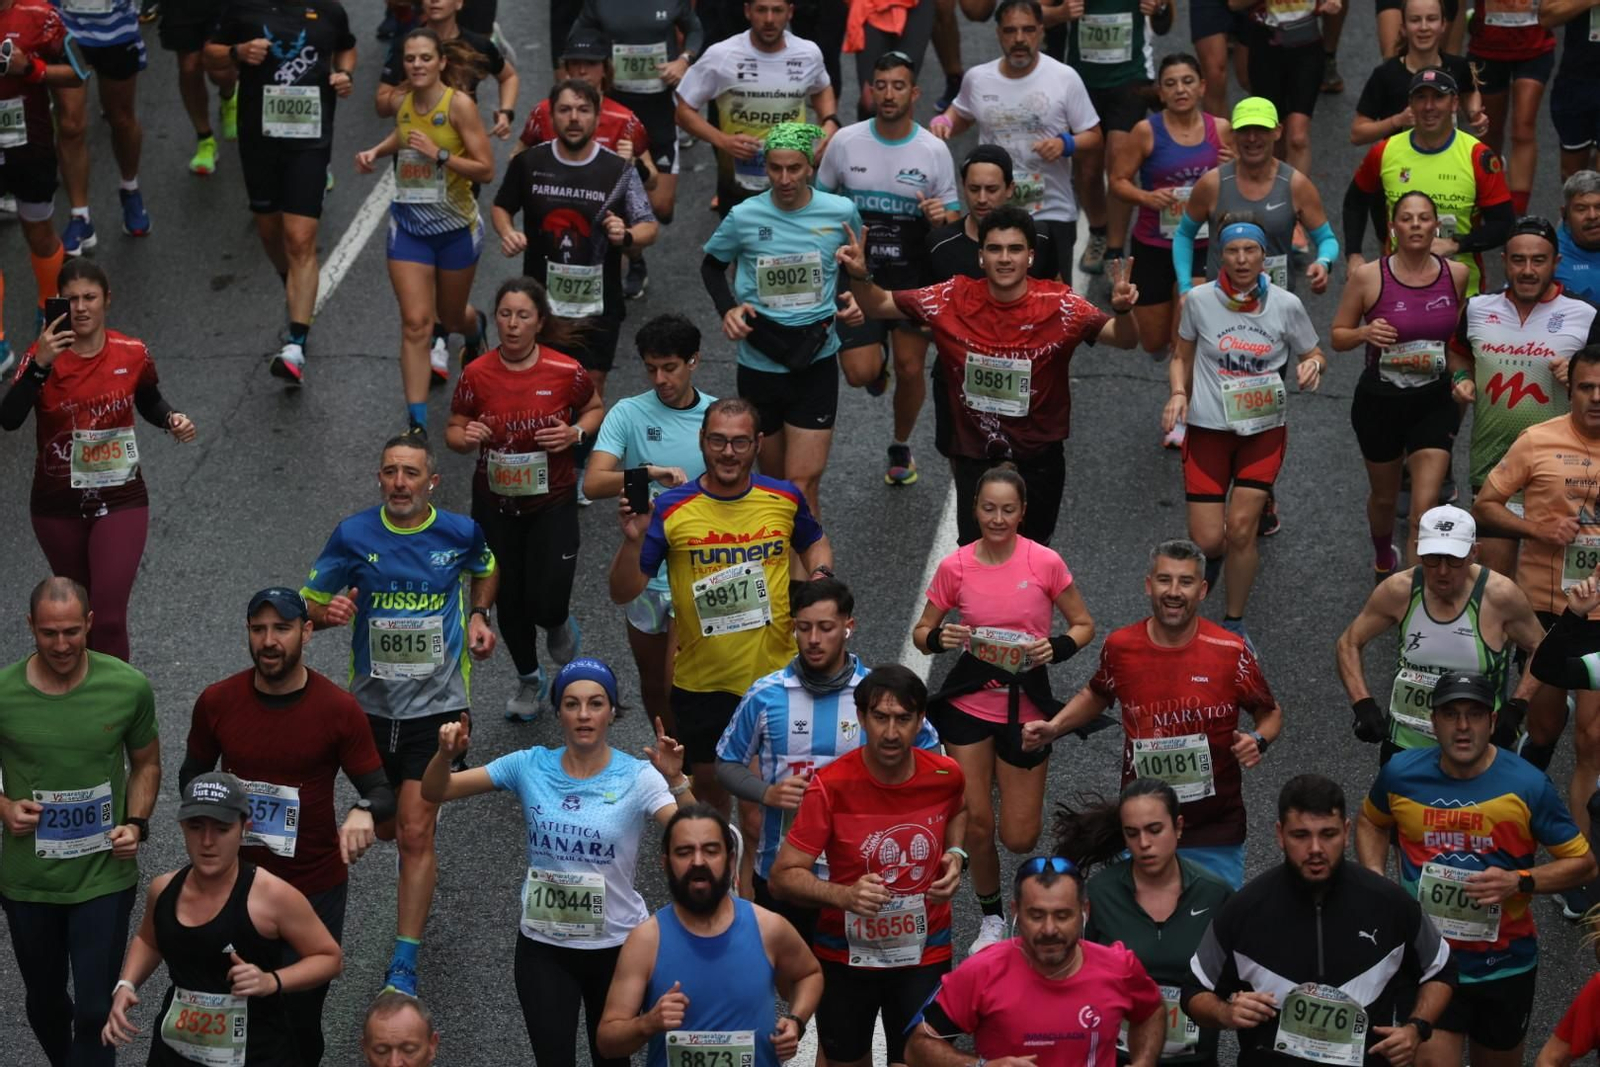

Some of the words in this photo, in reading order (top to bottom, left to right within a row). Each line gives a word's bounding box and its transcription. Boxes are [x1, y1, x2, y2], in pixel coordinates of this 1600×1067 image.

[1087, 26, 1120, 42] 7017
[622, 57, 655, 72] 7873
[268, 99, 313, 115] 10202
[532, 184, 606, 202] PARMARATHON
[555, 277, 592, 295] 7972
[767, 268, 807, 287] 9902
[1219, 336, 1274, 355] Chicago
[1481, 341, 1555, 357] maratón
[975, 369, 1013, 390] 9581
[1234, 389, 1273, 411] 7984
[81, 441, 122, 463] 8095
[691, 540, 784, 565] runners
[371, 592, 446, 611] TUSSAM
[705, 580, 750, 607] 8917
[380, 634, 427, 653] 6815
[1154, 702, 1235, 728] MARATÓN
[1140, 752, 1198, 776] 10181
[47, 805, 96, 828] 2306
[1423, 808, 1484, 831] NEVER
[540, 821, 600, 839] ATLETICA
[1424, 831, 1464, 848] GIVE
[1470, 834, 1494, 849] UP
[534, 886, 592, 911] 10344
[853, 913, 915, 940] 15656
[175, 1008, 226, 1035] 8523
[1294, 999, 1348, 1030] 9776
[681, 1051, 733, 1067] 8873
